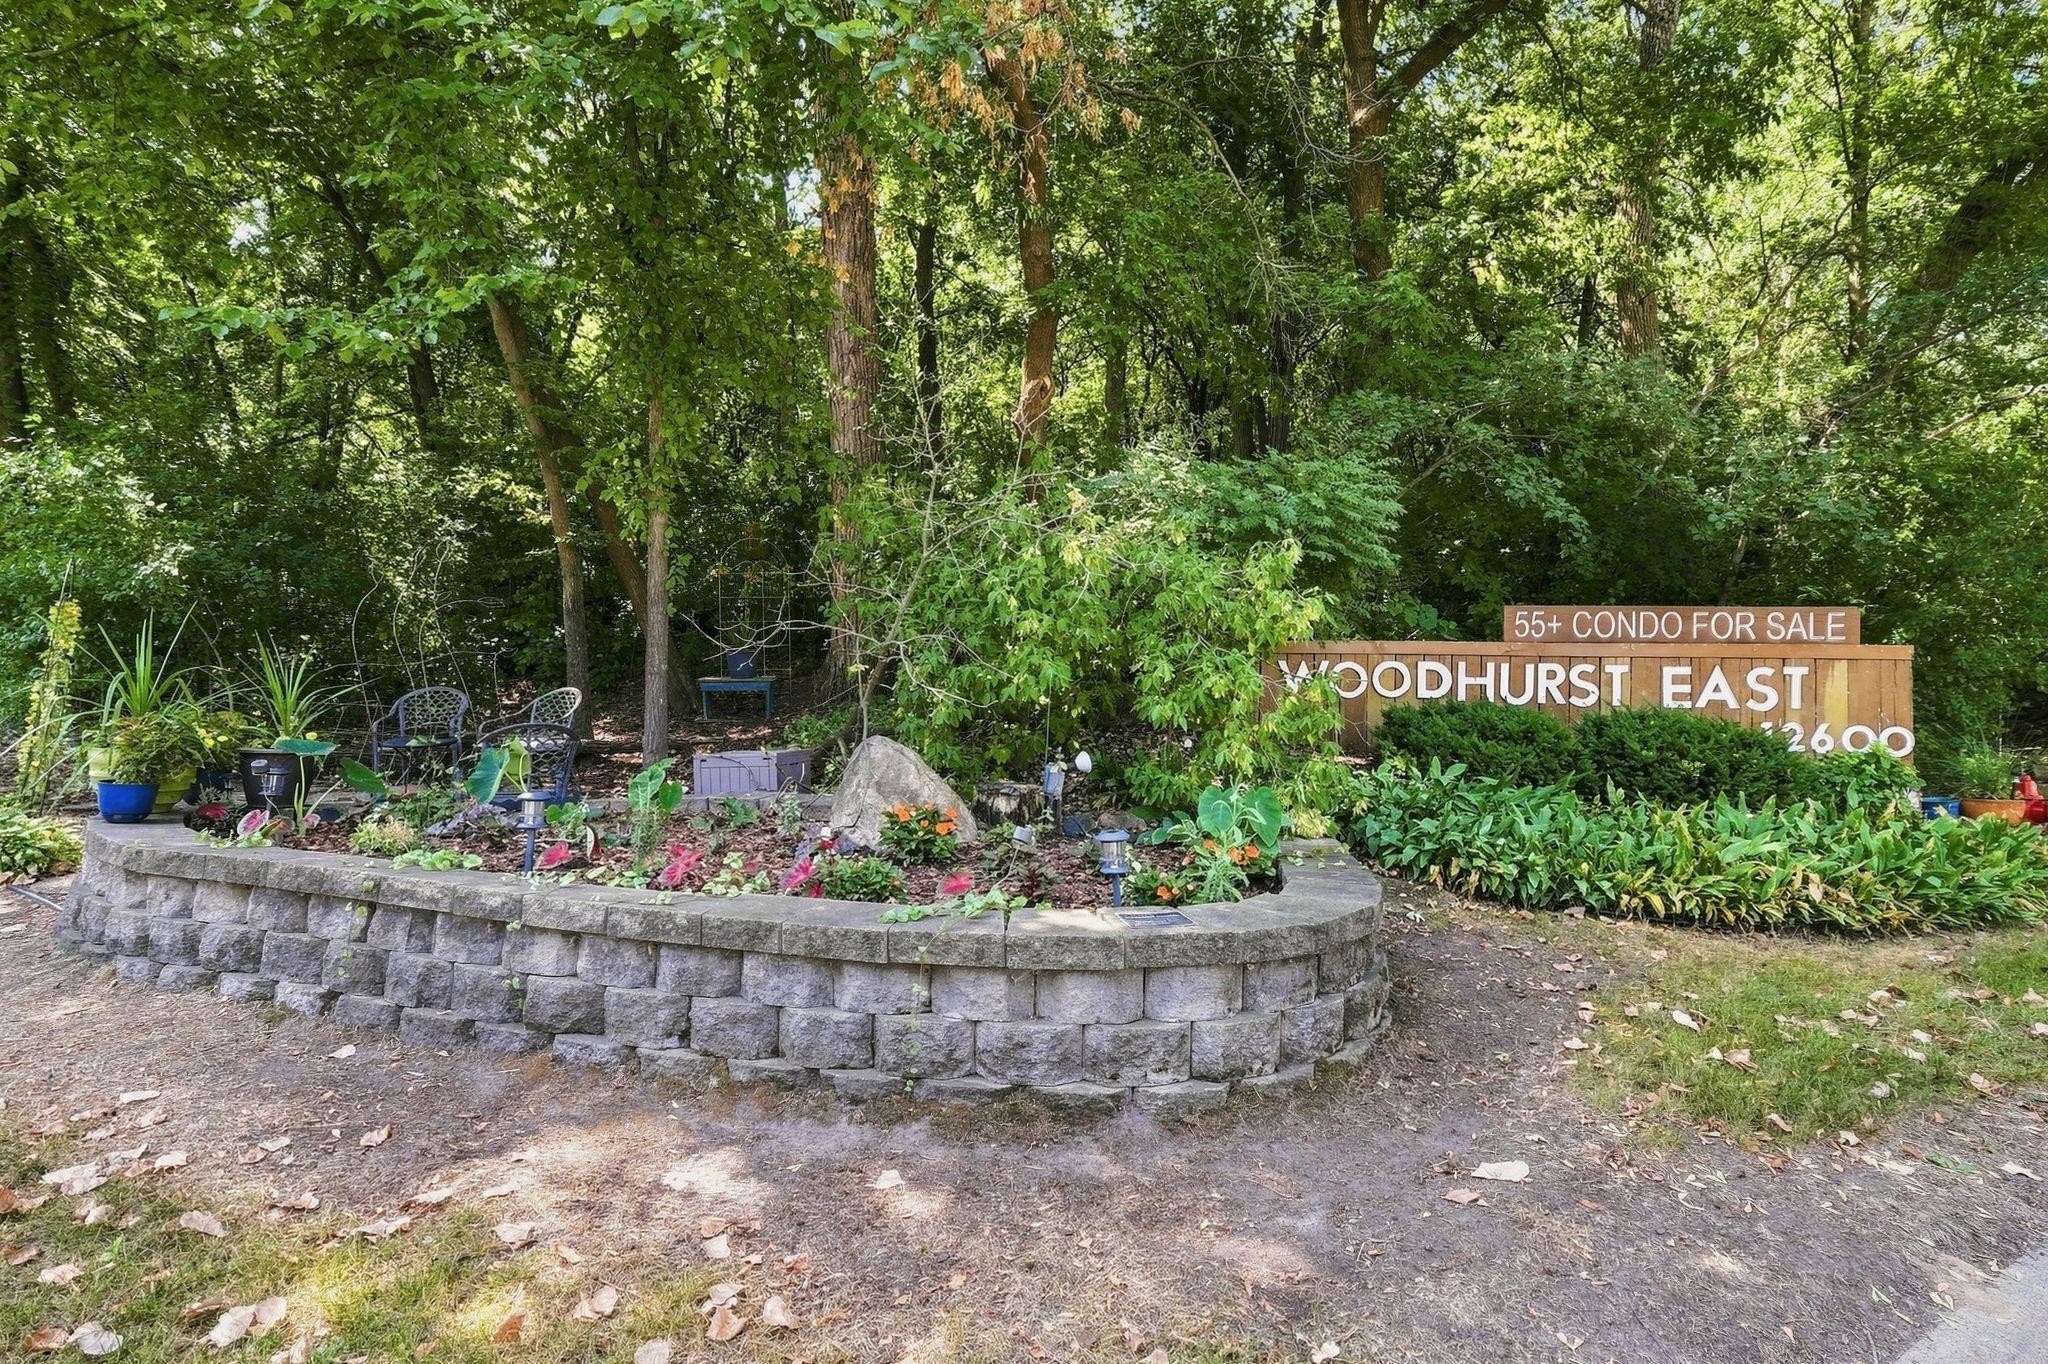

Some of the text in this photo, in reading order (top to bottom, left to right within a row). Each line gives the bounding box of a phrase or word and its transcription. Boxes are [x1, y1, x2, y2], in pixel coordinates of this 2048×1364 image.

[1514, 611, 1847, 640] 55+ CONDO FOR SALE
[1277, 659, 1810, 712] WOODHURST EAST
